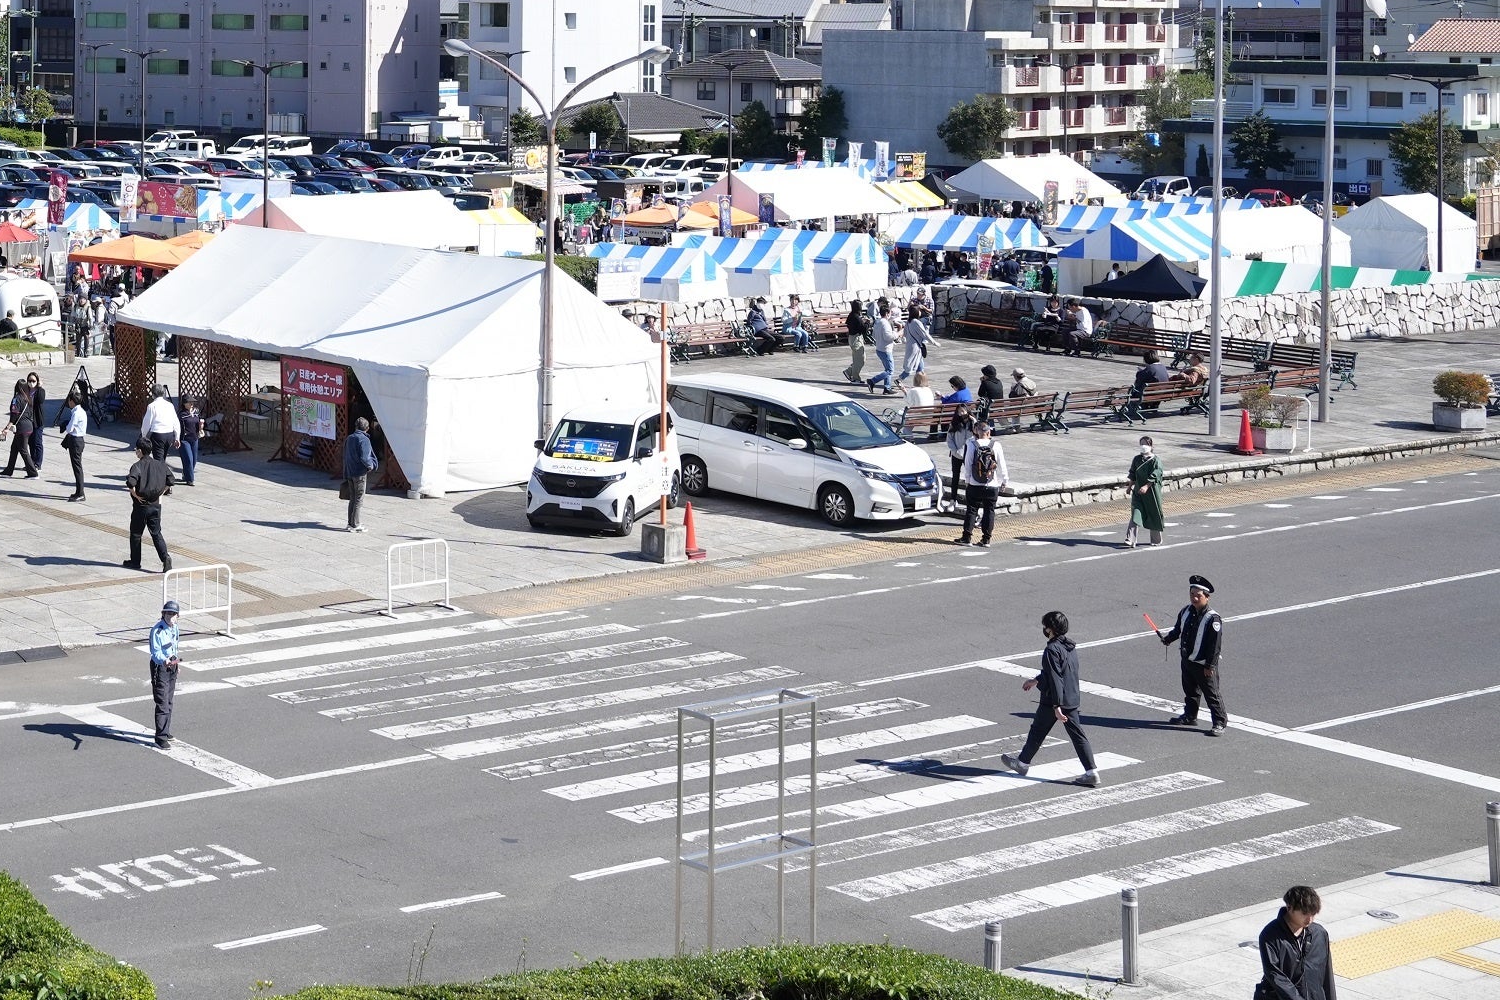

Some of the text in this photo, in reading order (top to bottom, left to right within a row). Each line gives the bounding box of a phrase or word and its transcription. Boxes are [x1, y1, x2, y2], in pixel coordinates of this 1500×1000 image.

[1348, 184, 1368, 193] 出口
[299, 368, 343, 386] 日産オーナー様
[298, 381, 343, 398] 専用休憩エリア
[551, 464, 597, 473] SAKURA
